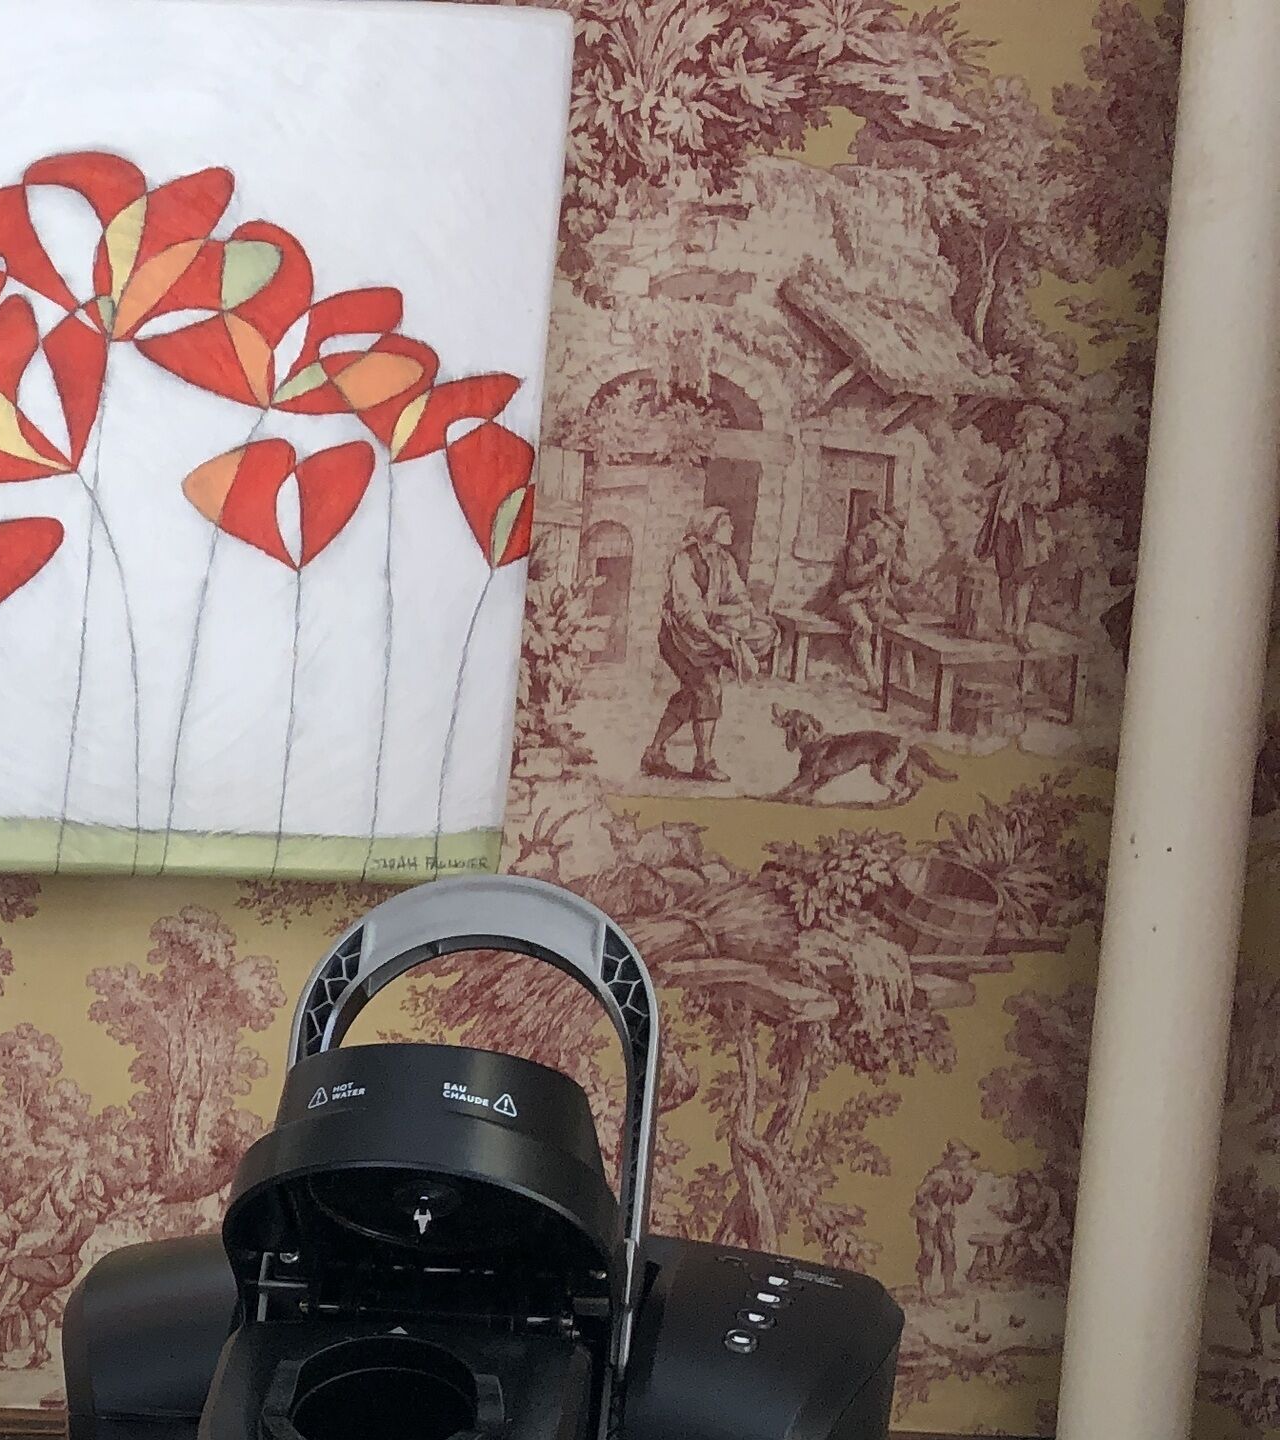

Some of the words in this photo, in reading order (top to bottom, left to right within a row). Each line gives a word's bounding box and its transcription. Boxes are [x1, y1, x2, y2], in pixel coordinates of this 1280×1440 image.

[333, 1082, 354, 1092] HOT
[444, 1083, 467, 1093] EAU
[332, 1088, 365, 1100] WATER
[442, 1090, 489, 1107] CHAUDE
